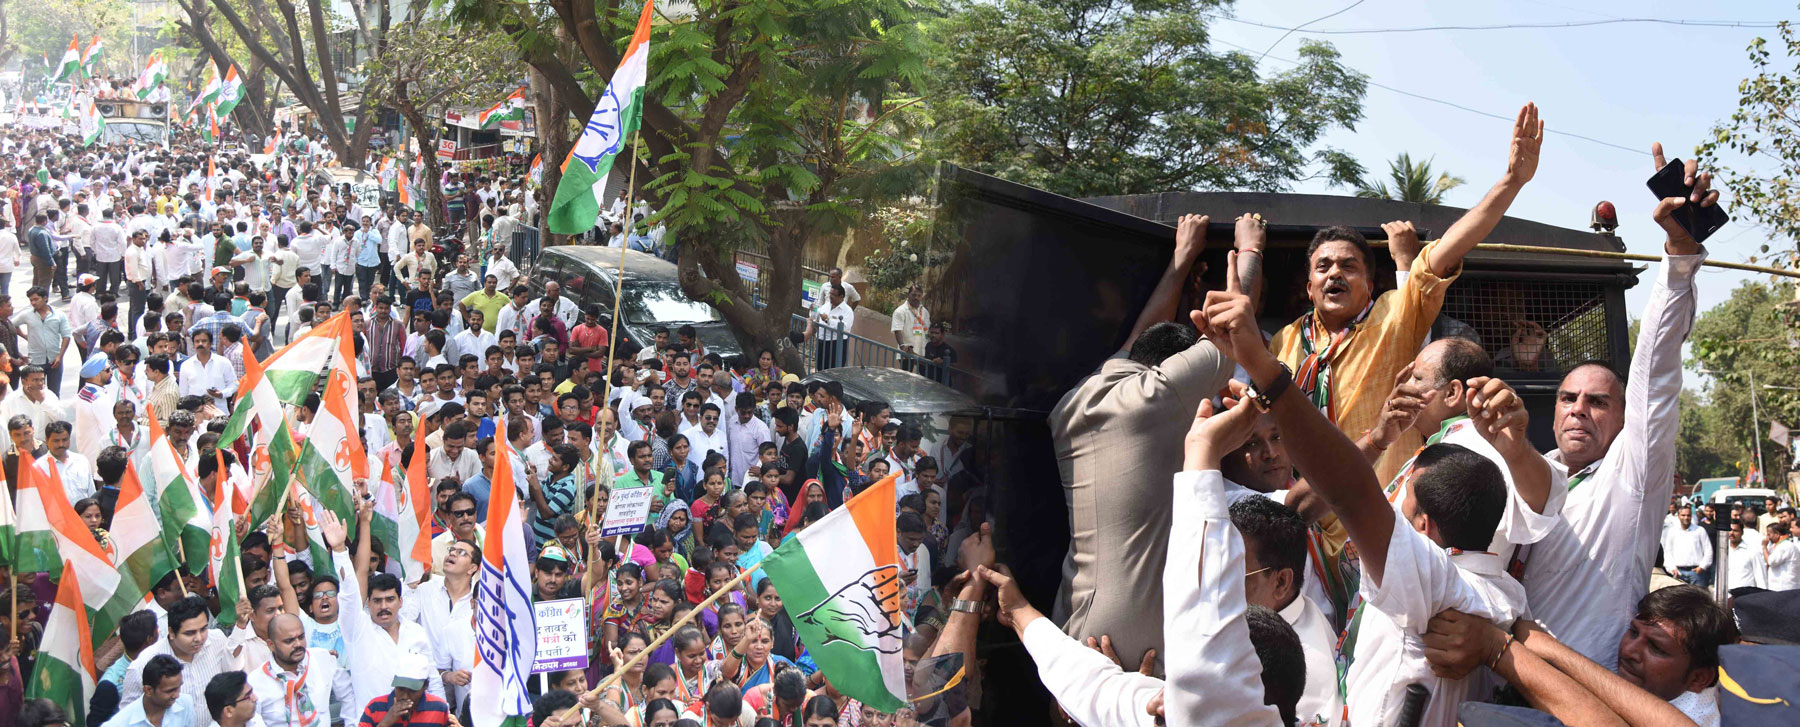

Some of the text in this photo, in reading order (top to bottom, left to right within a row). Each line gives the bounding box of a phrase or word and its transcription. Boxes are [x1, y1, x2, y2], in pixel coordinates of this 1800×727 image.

[442, 141, 454, 150] 3G
[544, 620, 568, 633] तावडे
[563, 631, 576, 642] की
